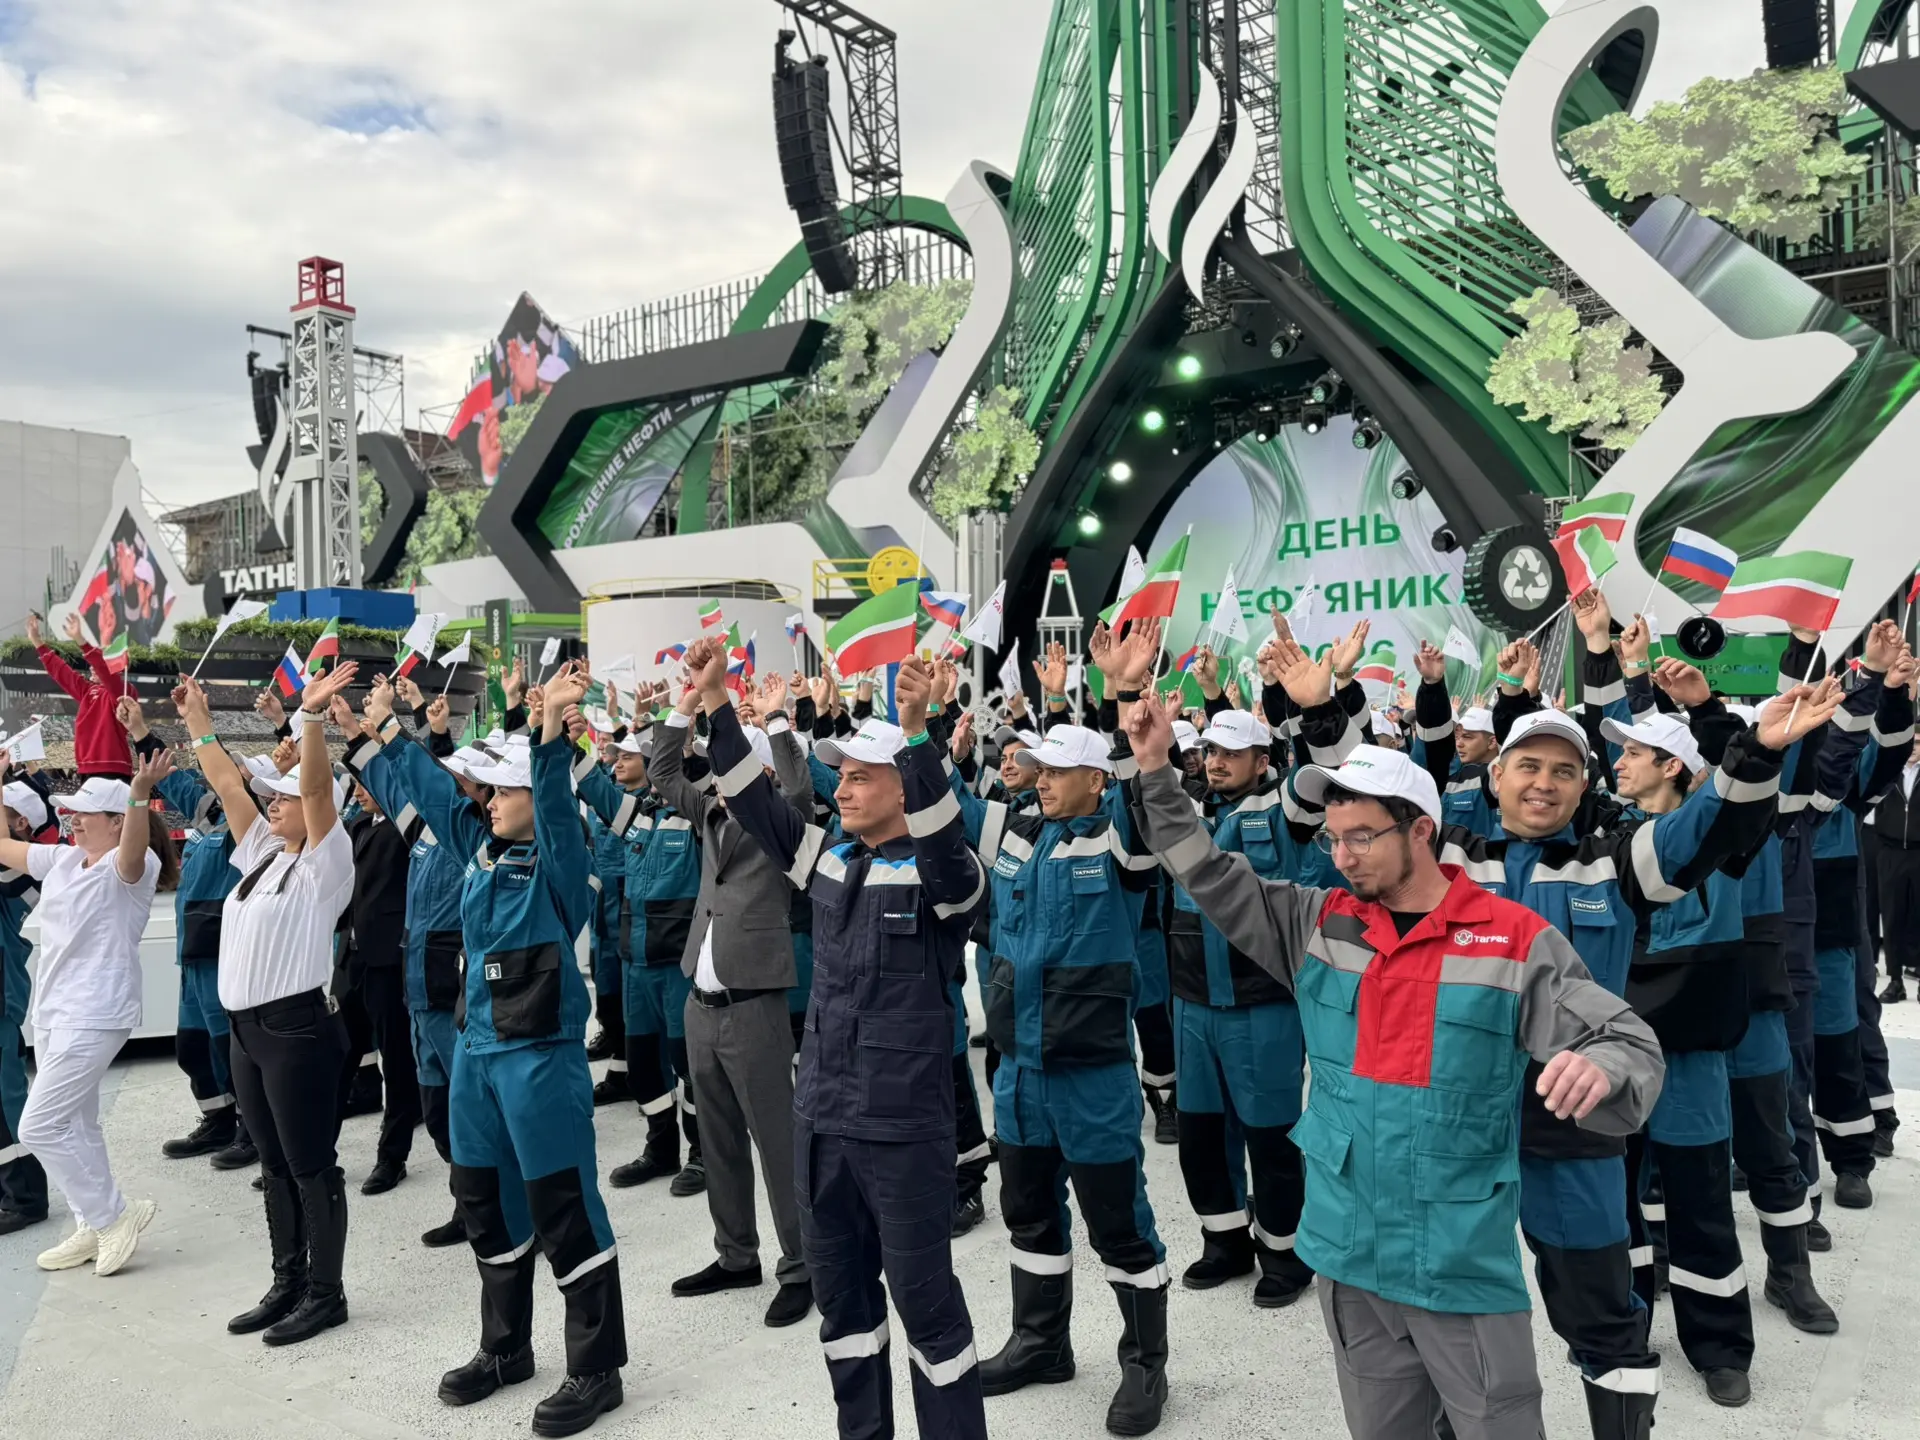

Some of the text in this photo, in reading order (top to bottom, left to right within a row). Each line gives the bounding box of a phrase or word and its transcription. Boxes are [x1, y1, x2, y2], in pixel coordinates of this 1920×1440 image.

[564, 454, 625, 549] РОЖДЕНИЕ
[622, 407, 673, 459] НЕФТИ
[1277, 513, 1401, 561] ДЕНЬ
[1200, 573, 1466, 622] НЕФЯНИК
[1075, 868, 1102, 876] TATNEFT
[1573, 901, 1605, 910] TATNEFT
